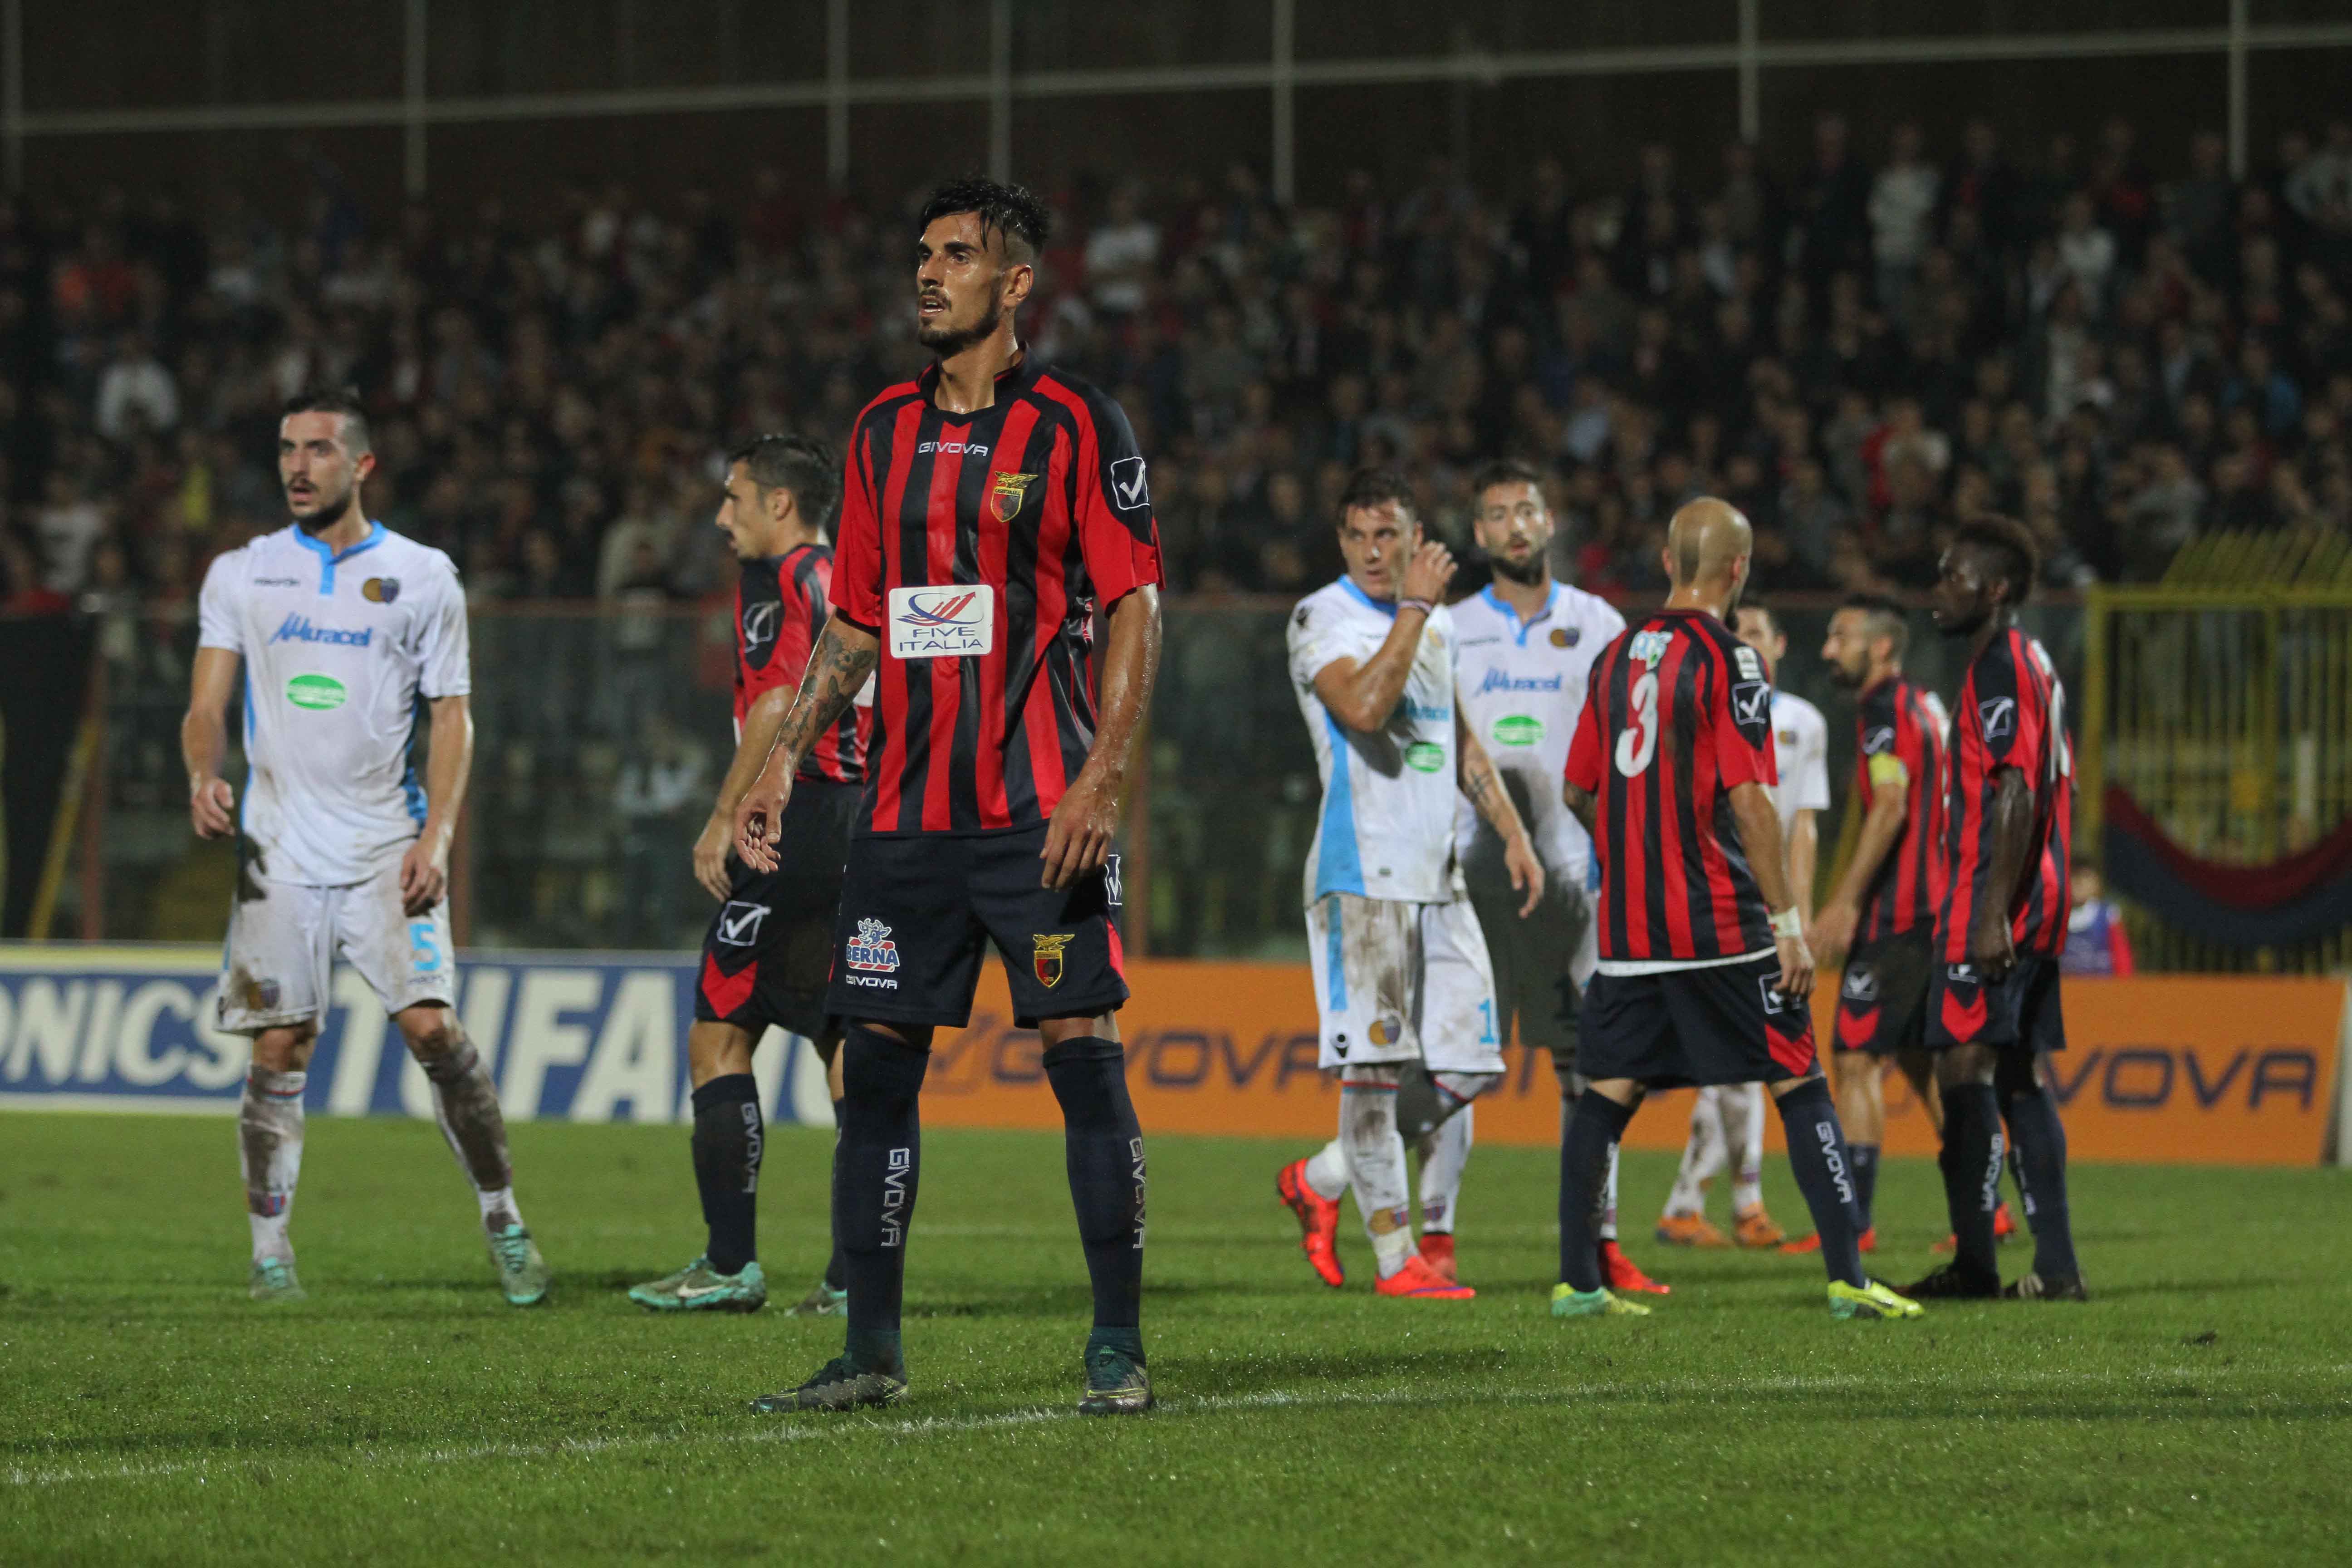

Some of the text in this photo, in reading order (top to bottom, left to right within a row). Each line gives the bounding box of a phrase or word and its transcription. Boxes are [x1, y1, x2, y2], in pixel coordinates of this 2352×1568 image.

[918, 441, 989, 456] GIVOVA
[900, 639, 984, 652] ITALIA
[913, 627, 975, 637] FIVE
[1615, 672, 1659, 778] 3
[409, 924, 442, 971] 5
[846, 944, 900, 967] BERNA
[846, 974, 897, 989] GIVOVA
[0, 976, 254, 1089] NICS
[991, 1029, 1333, 1092] GOVA
[1816, 1121, 1852, 1203] GIVOVA
[881, 1147, 910, 1247] GIVOVA
